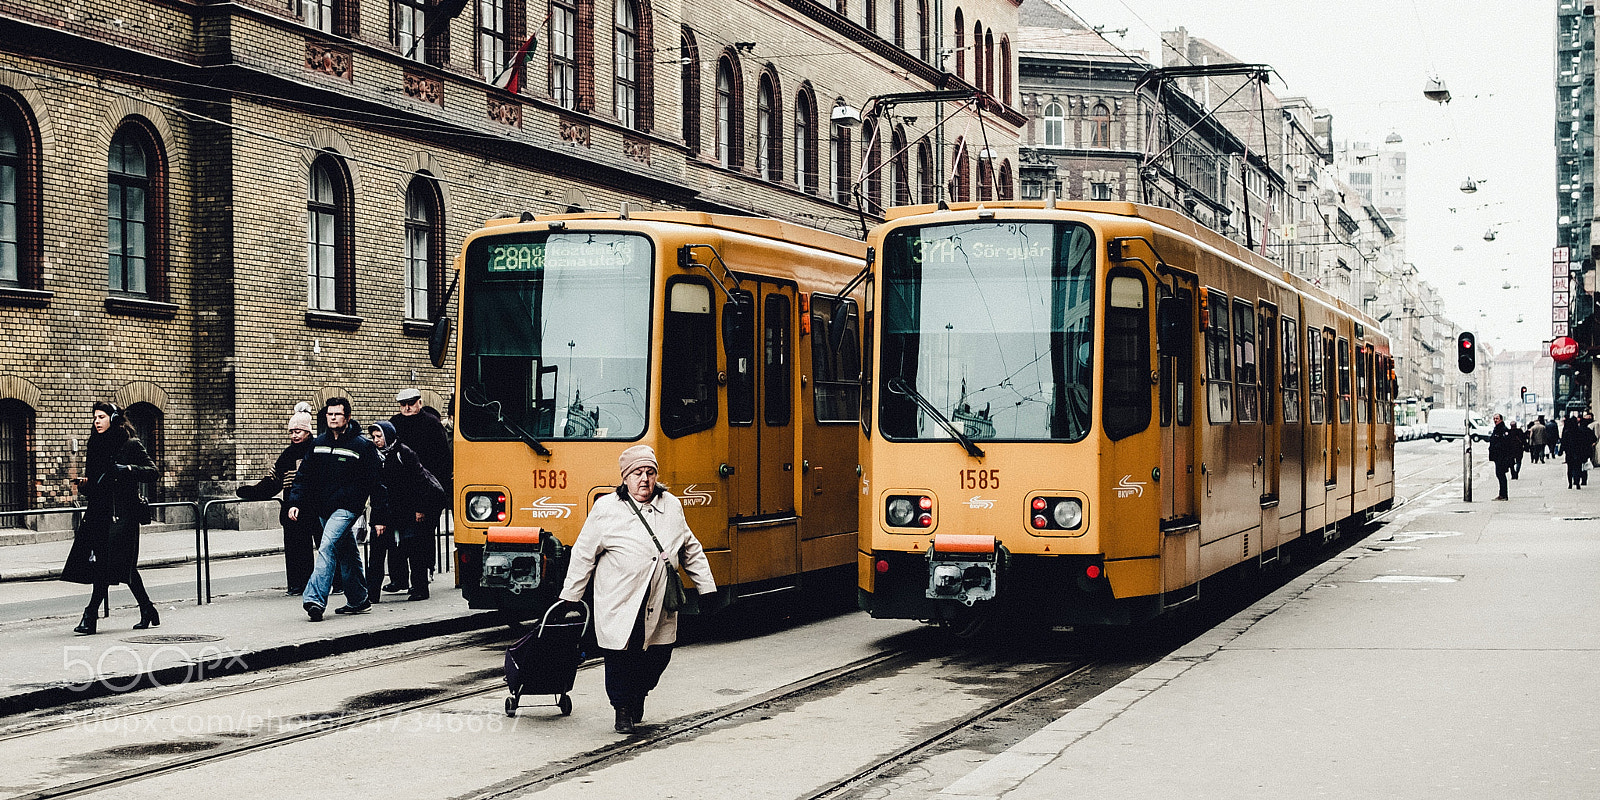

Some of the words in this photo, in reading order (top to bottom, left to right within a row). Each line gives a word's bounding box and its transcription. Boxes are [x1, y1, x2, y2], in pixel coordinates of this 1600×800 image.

[493, 246, 531, 270] 28A
[532, 469, 567, 489] 1583
[959, 469, 1000, 490] 1585
